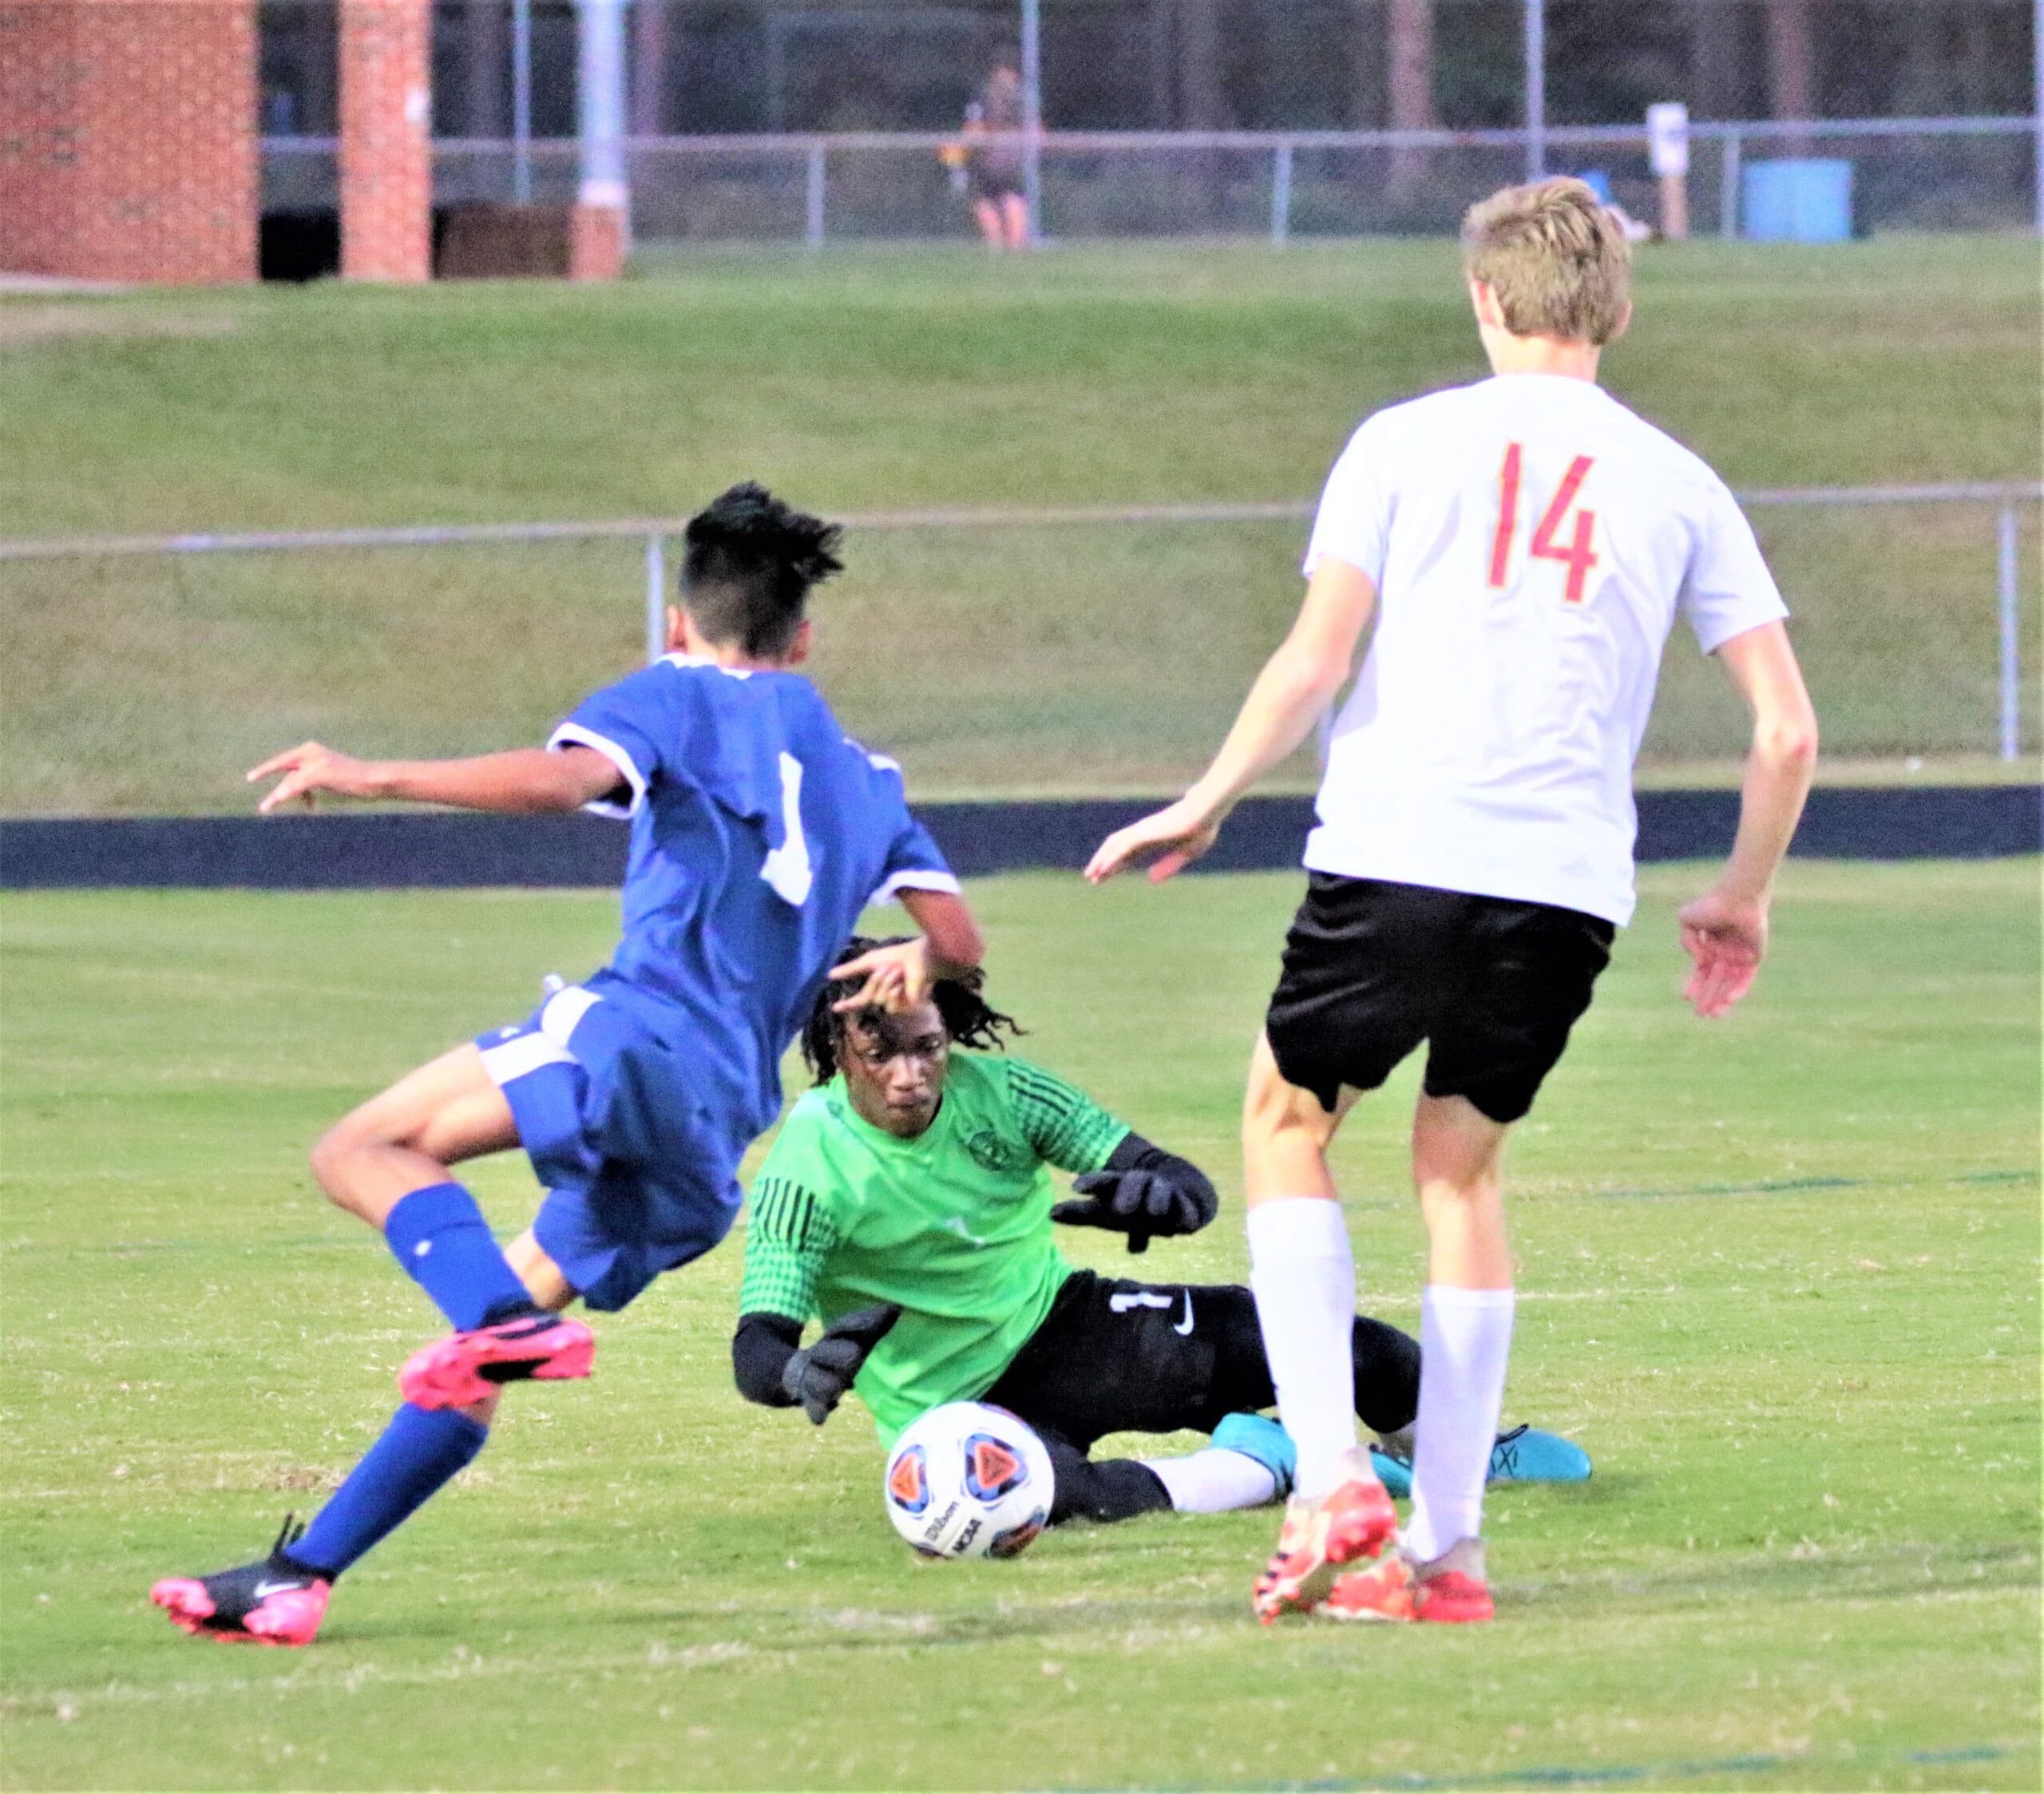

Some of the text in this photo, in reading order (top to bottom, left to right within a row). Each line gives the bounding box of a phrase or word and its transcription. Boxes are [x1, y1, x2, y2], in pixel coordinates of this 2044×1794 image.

[1487, 442, 1600, 604] 14
[1109, 1291, 1174, 1313] 1
[953, 1519, 982, 1554] NCAA
